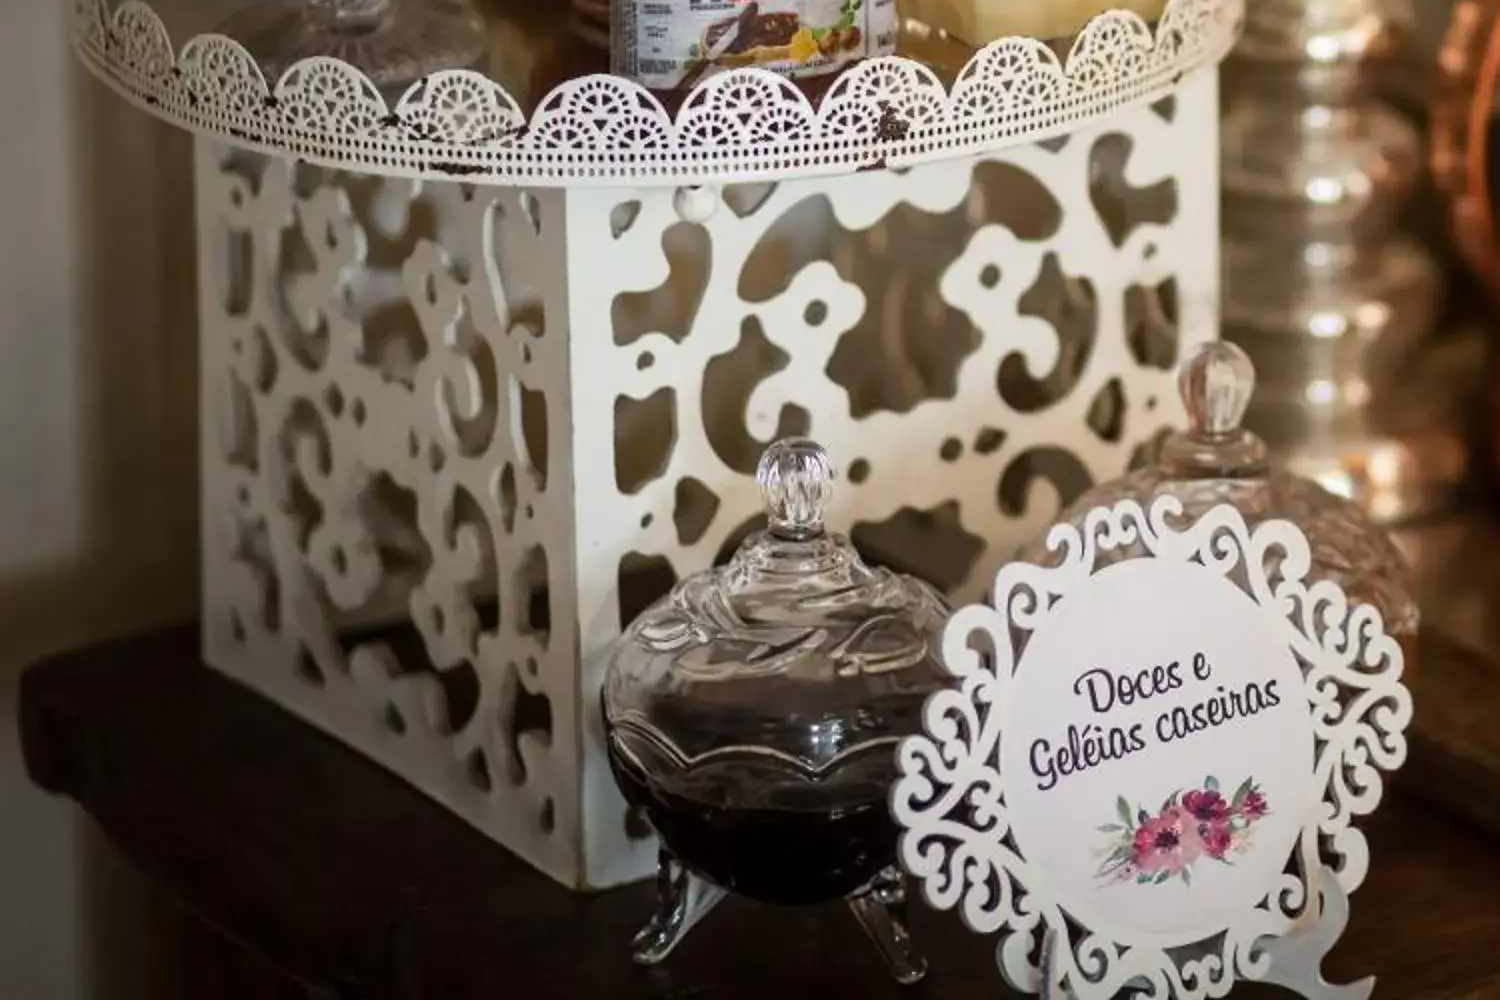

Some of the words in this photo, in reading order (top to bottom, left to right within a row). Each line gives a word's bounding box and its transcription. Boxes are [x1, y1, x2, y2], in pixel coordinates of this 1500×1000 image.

[1073, 660, 1183, 713] Doces
[1192, 651, 1212, 681] e
[1028, 722, 1146, 791] Geléias
[1155, 679, 1281, 743] caseiras
